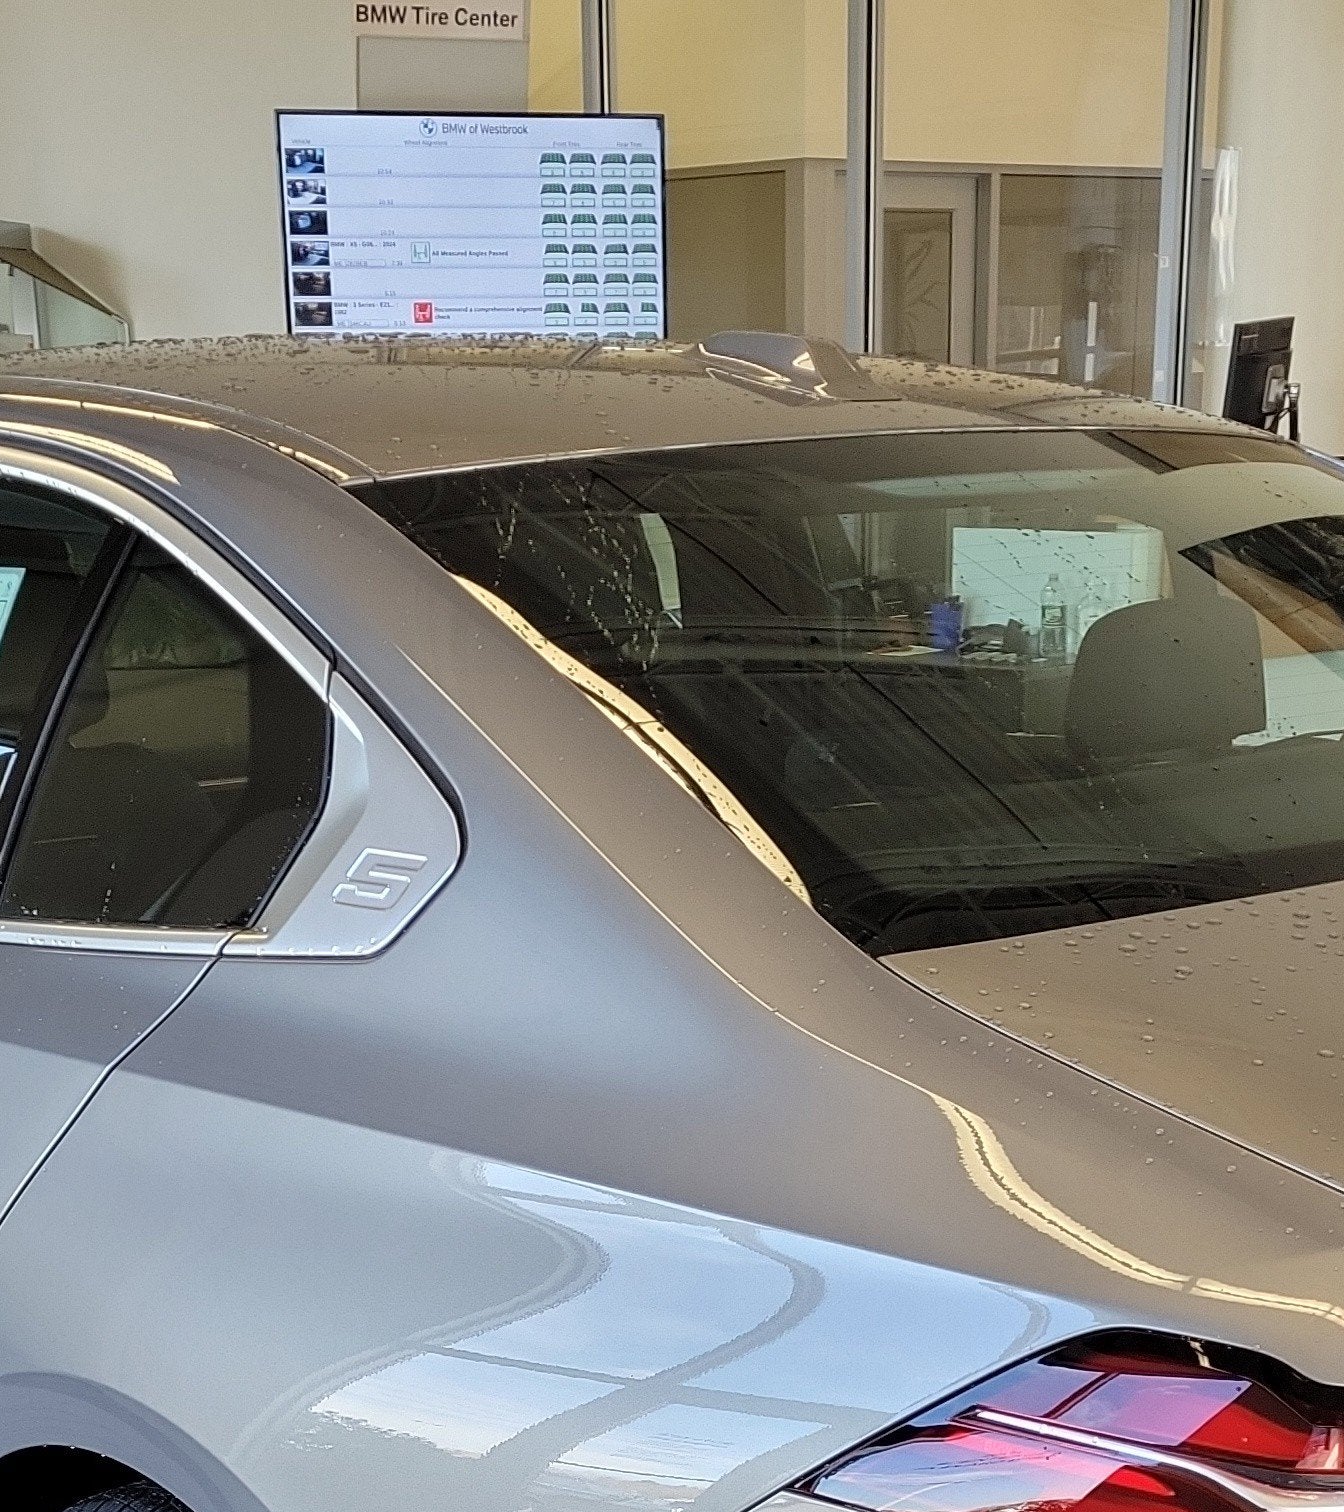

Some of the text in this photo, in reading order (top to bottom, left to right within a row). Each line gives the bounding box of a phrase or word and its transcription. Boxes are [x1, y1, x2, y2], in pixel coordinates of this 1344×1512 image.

[356, 4, 518, 28] BMW Tire Center
[442, 123, 529, 136] BMW of Westbrook
[332, 848, 428, 910] 5
